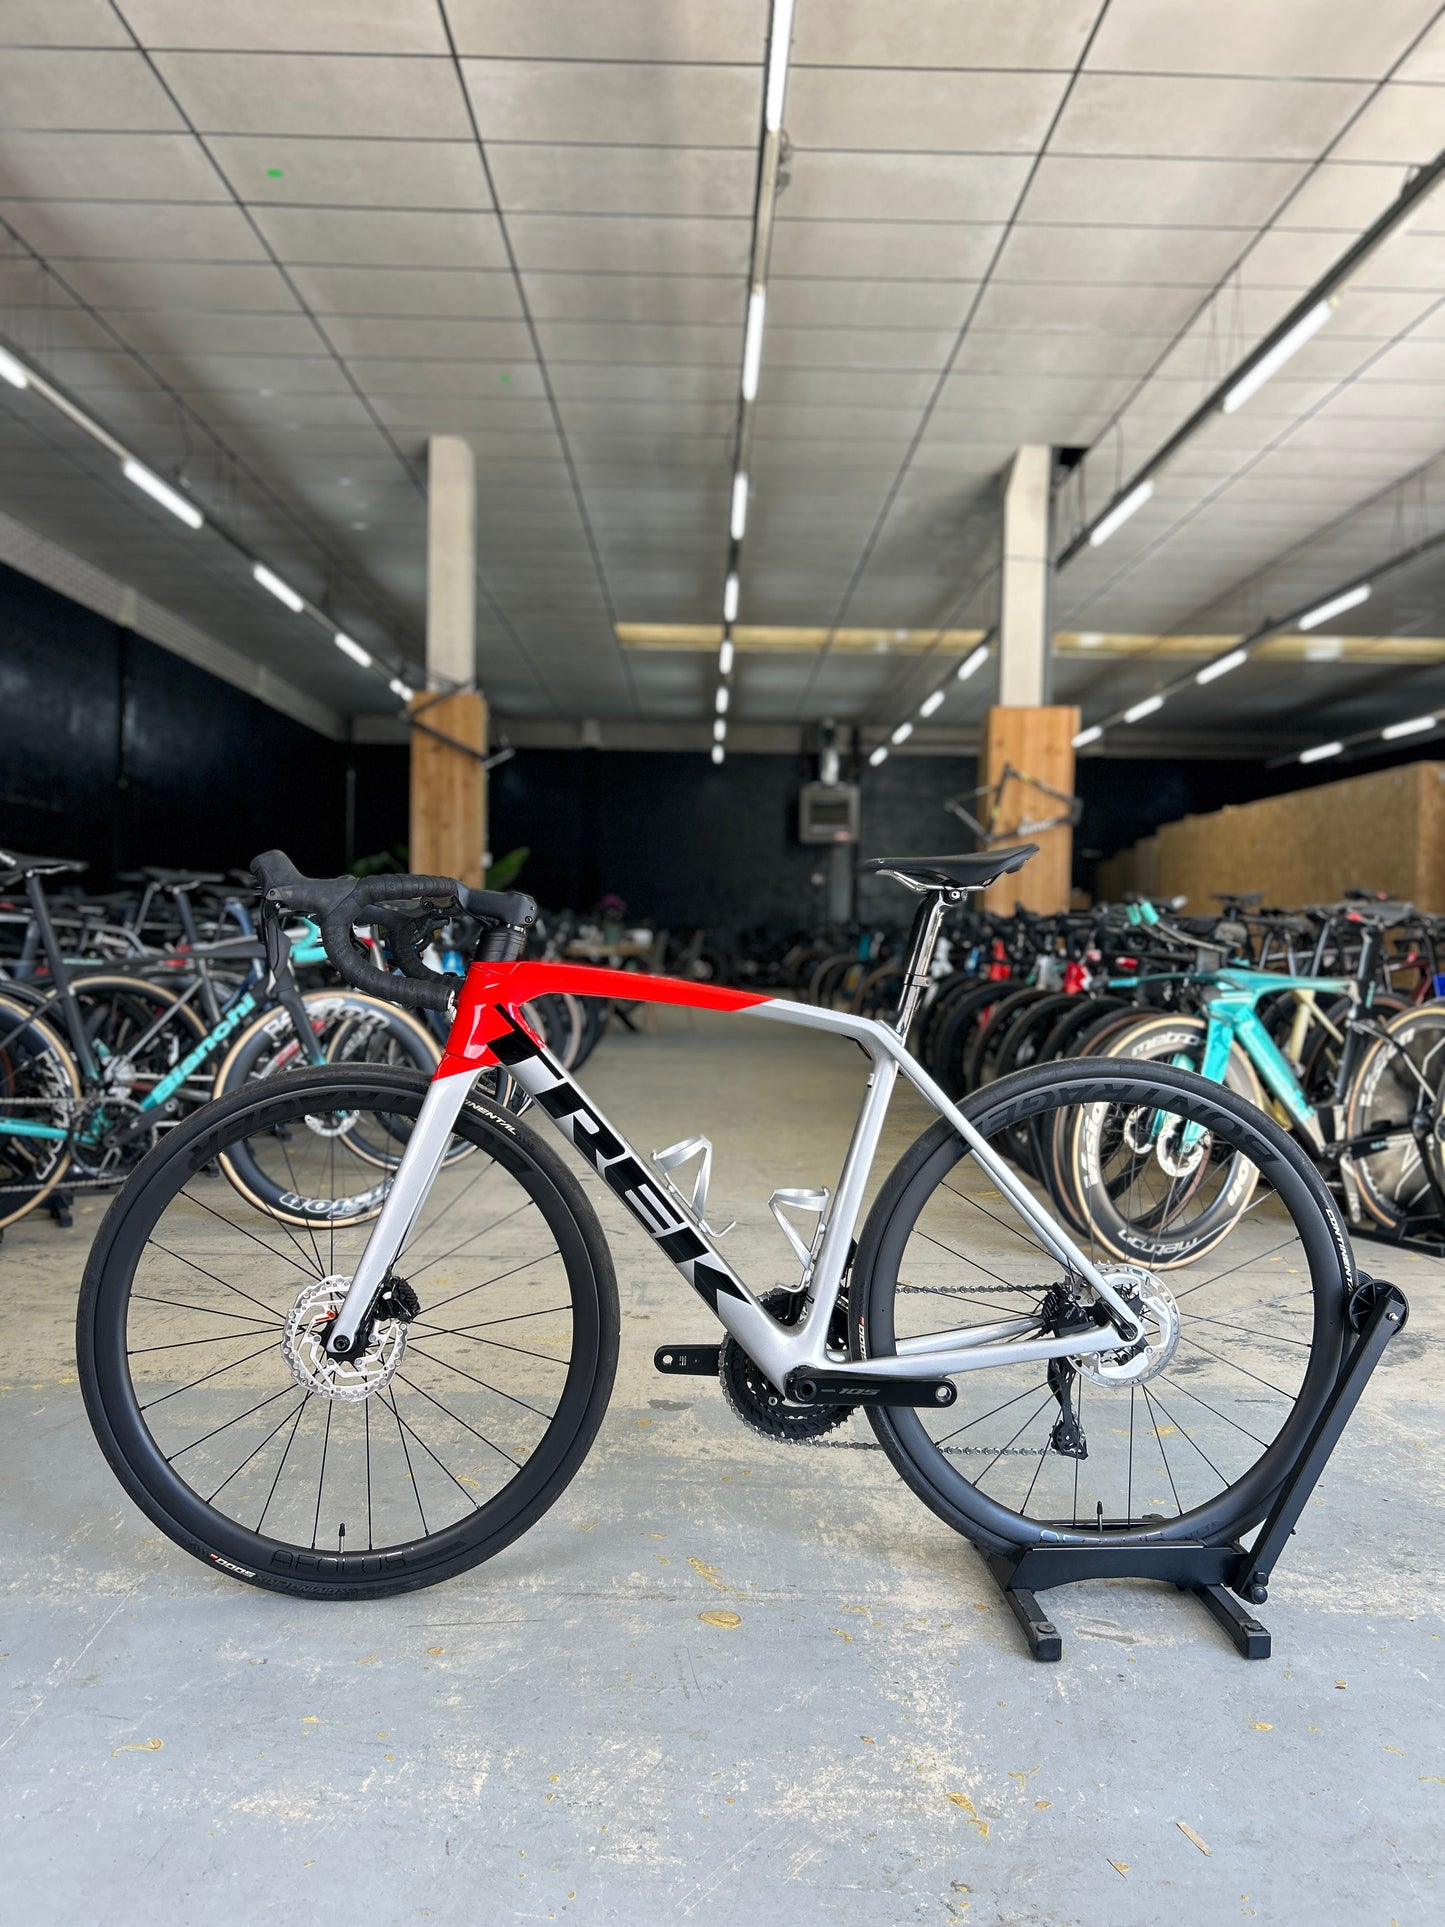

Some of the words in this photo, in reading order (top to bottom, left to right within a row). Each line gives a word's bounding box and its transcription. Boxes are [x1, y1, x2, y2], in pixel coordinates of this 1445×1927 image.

[150, 991, 256, 1104] Bianchi
[464, 1099, 516, 1135] INENTAL
[485, 1003, 752, 1315] TREK
[838, 1387, 881, 1396] 105
[214, 1557, 257, 1579] 5000
